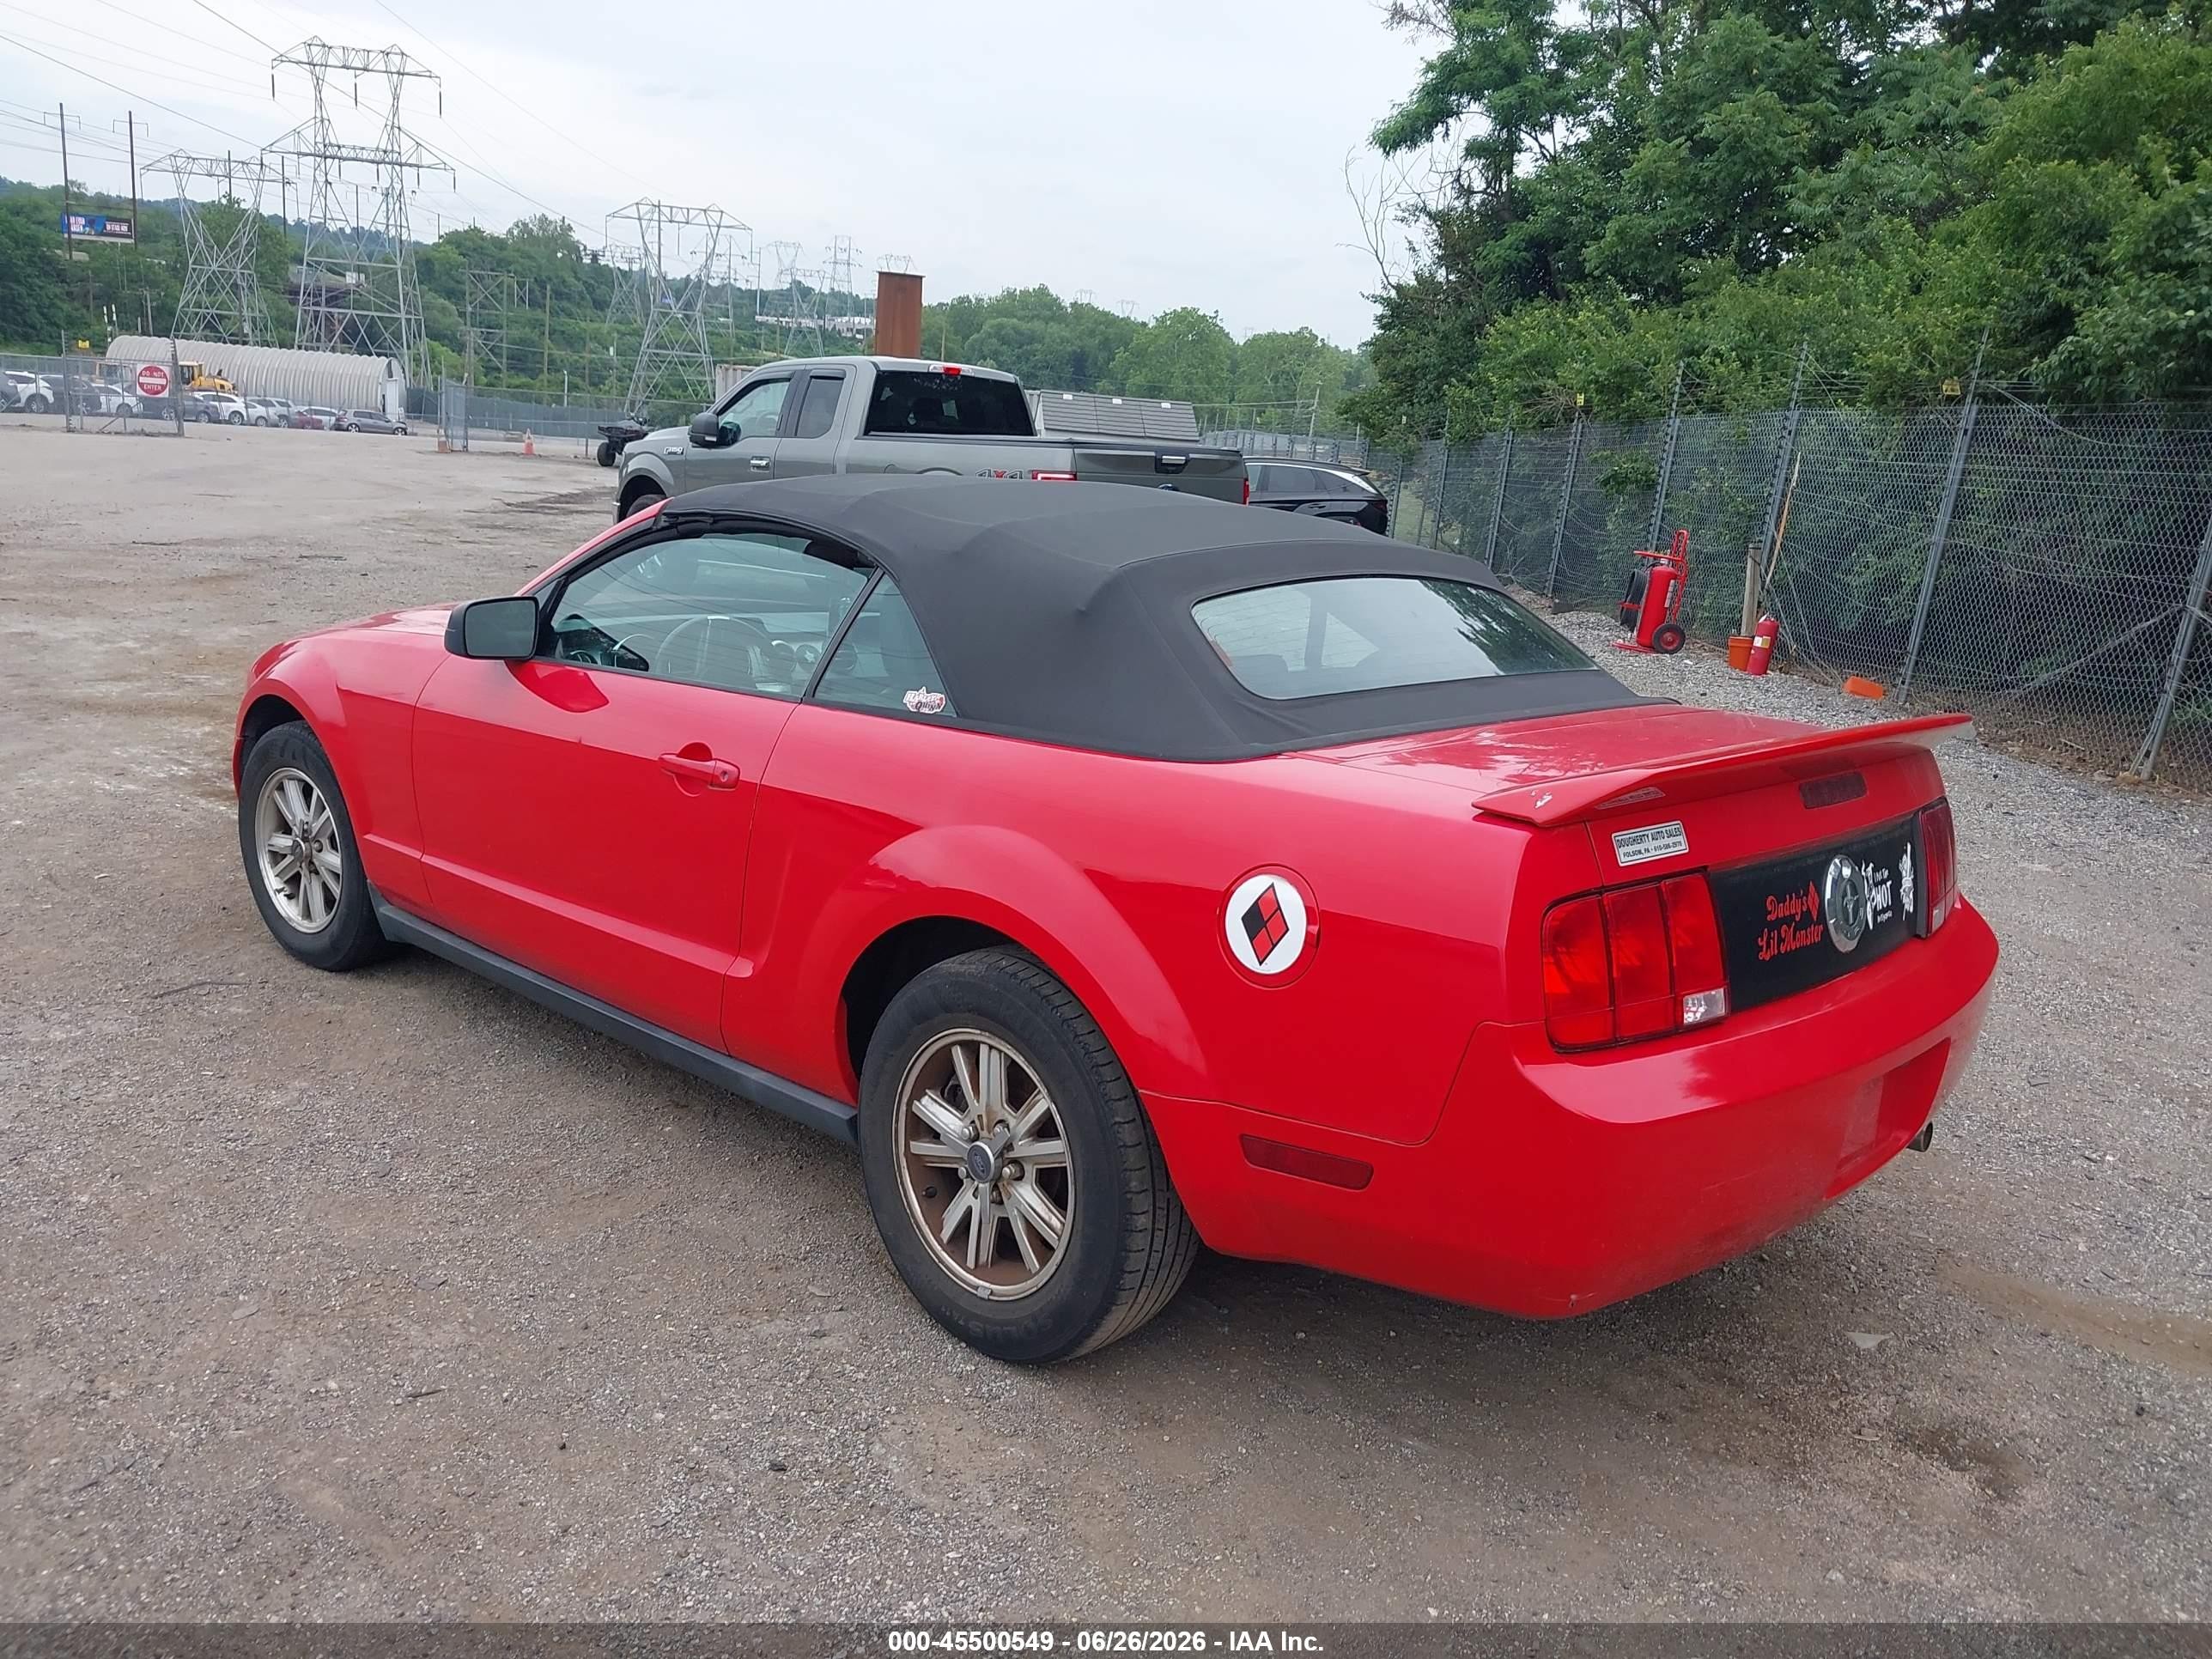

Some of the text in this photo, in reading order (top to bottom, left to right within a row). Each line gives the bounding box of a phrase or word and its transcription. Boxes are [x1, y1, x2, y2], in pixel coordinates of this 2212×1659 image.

[1616, 826, 1682, 848] DOUGHERTY AUTO SALES
[1765, 889, 1808, 921] Daddy's
[1758, 927, 1778, 961] Lil
[1780, 921, 1824, 954] Monster
